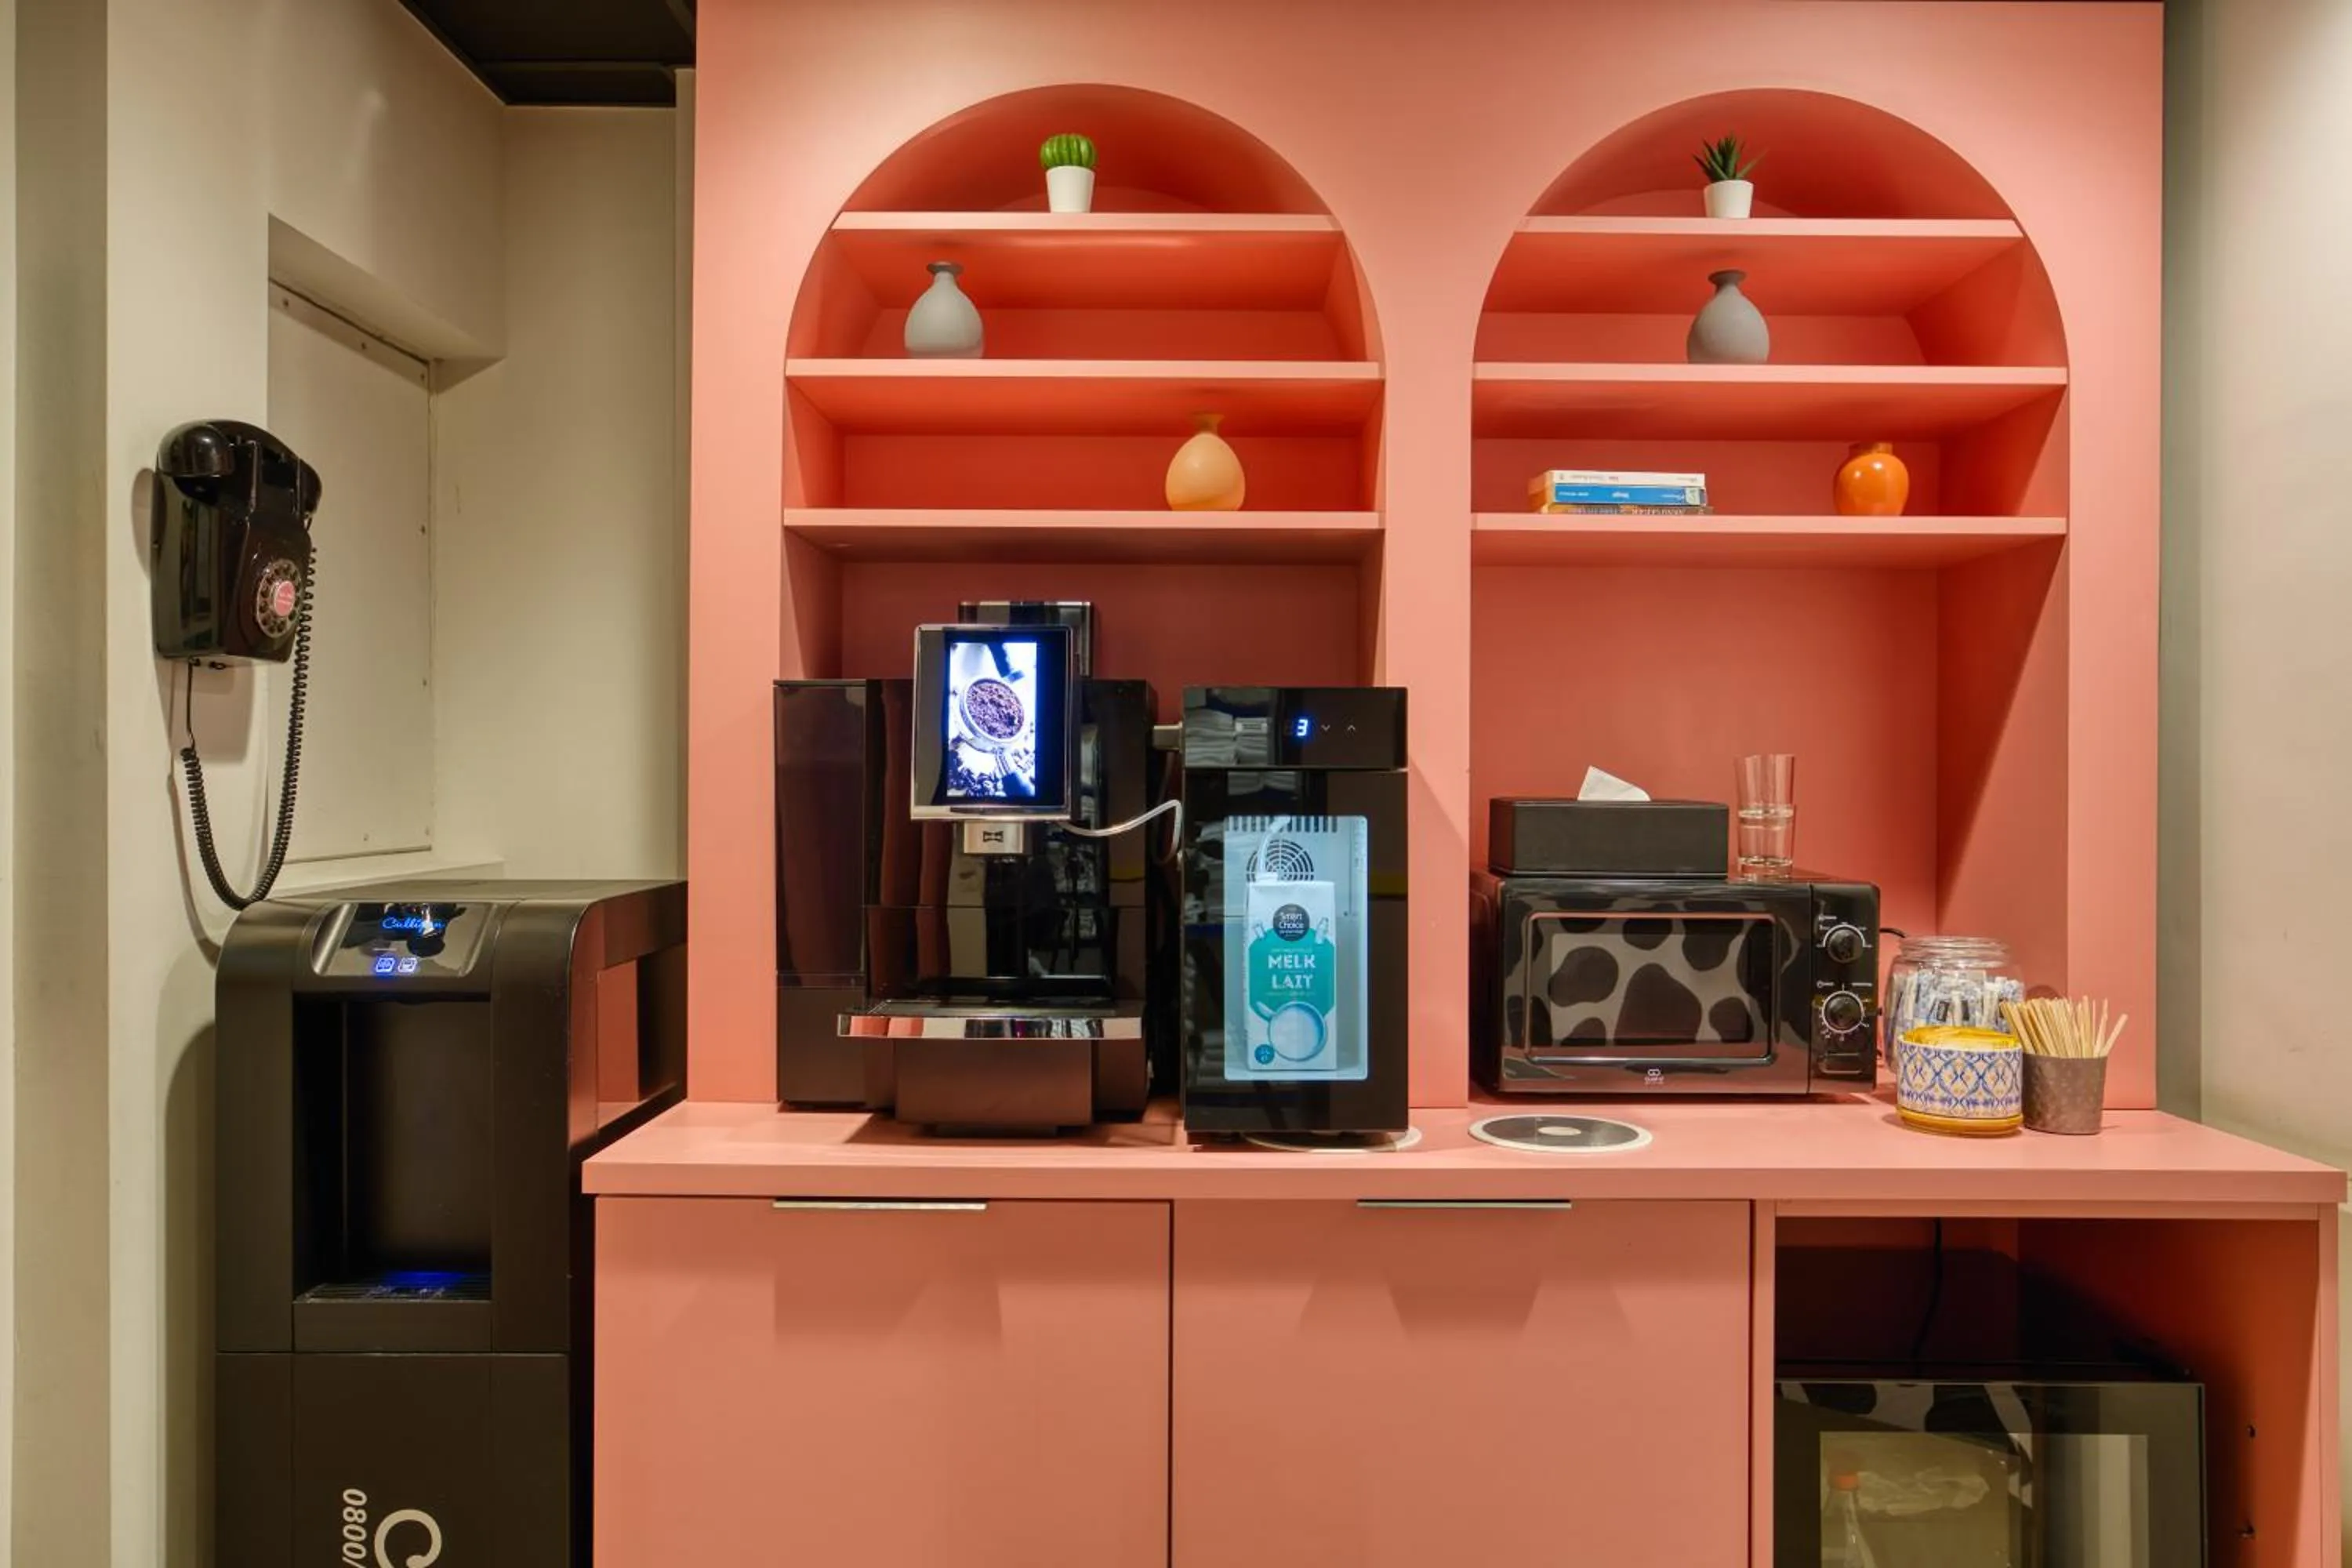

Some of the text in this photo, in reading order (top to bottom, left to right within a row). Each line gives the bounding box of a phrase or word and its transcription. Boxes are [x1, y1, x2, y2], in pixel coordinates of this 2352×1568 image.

[1296, 718, 1308, 737] 3
[382, 916, 445, 934] Cullign
[1268, 953, 1316, 969] MELK
[1272, 974, 1314, 989] LAIT
